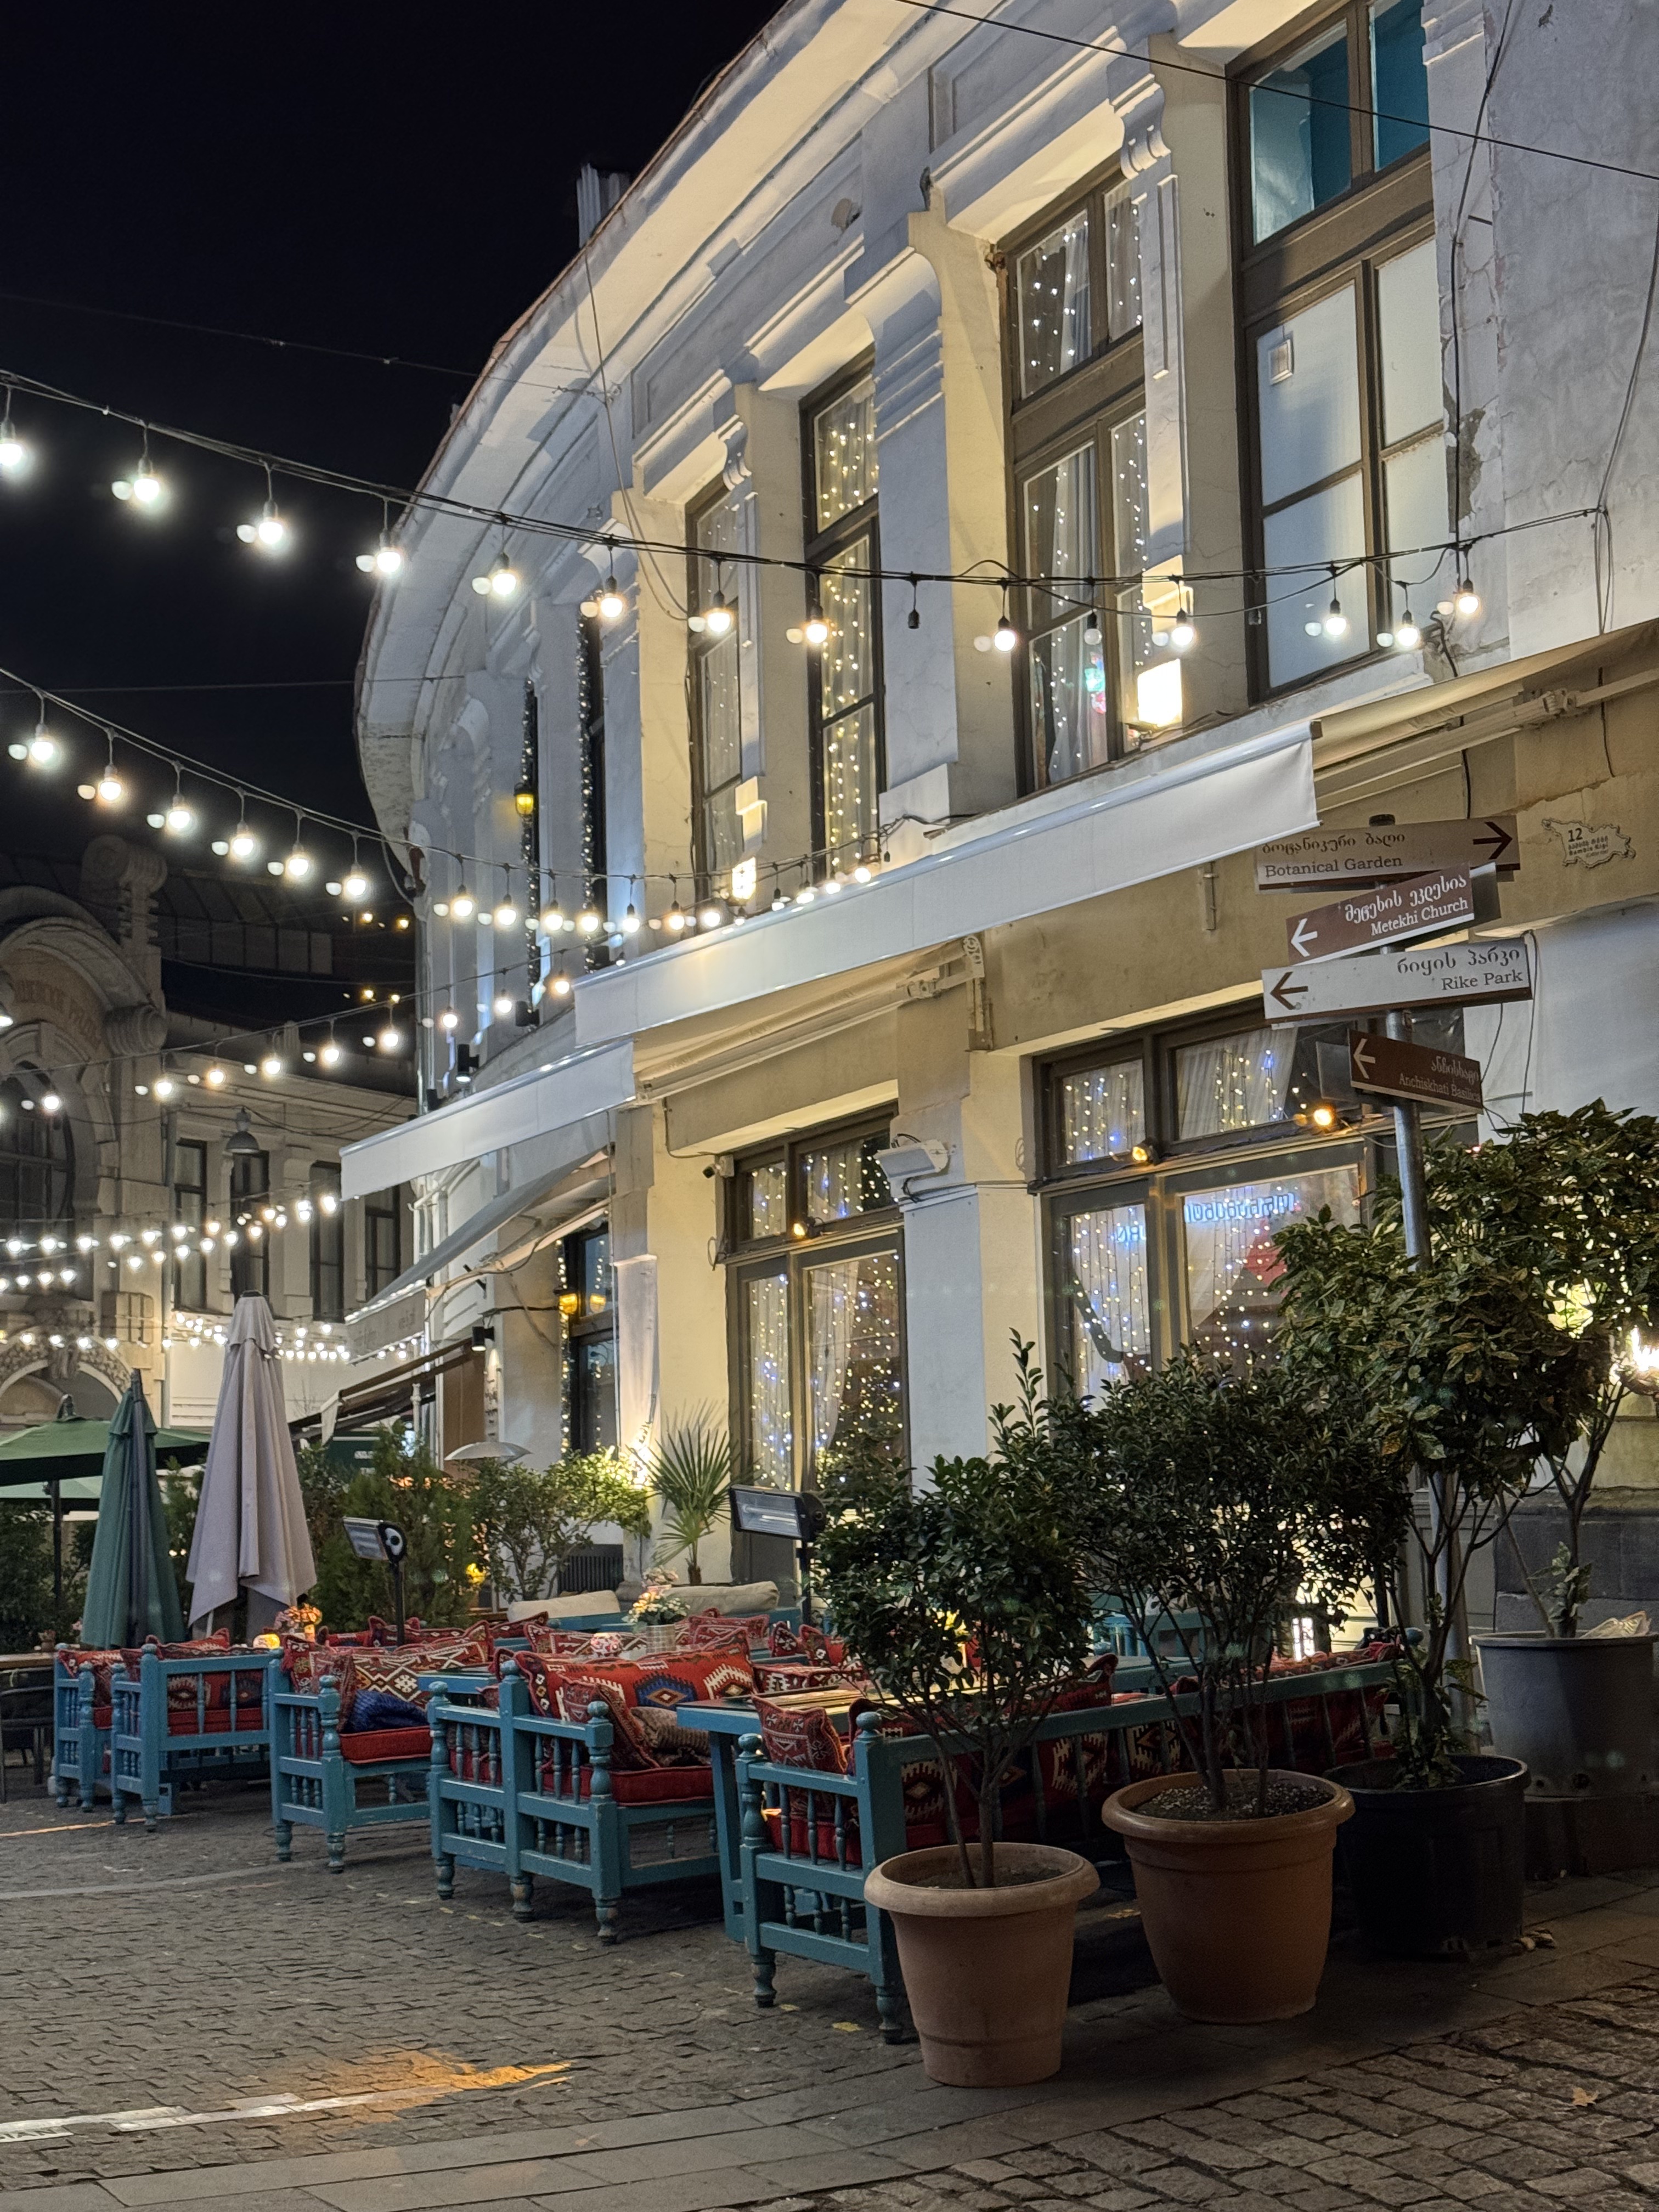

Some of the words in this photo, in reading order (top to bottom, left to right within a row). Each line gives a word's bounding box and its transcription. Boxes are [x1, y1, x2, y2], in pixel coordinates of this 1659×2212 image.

[1364, 832, 1406, 848] ბაღი
[1567, 827, 1583, 843] 12
[1265, 859, 1340, 878] Botanical
[1344, 856, 1403, 871] Garden
[1345, 889, 1403, 924] მეტეხის
[1409, 874, 1467, 907] ეკლესია
[1370, 910, 1419, 936] Metekhi
[1421, 896, 1469, 921] Church
[1397, 951, 1457, 977] რიყის
[1467, 946, 1520, 967] პარკი
[1441, 975, 1479, 991] Rike
[1483, 969, 1524, 986] Park
